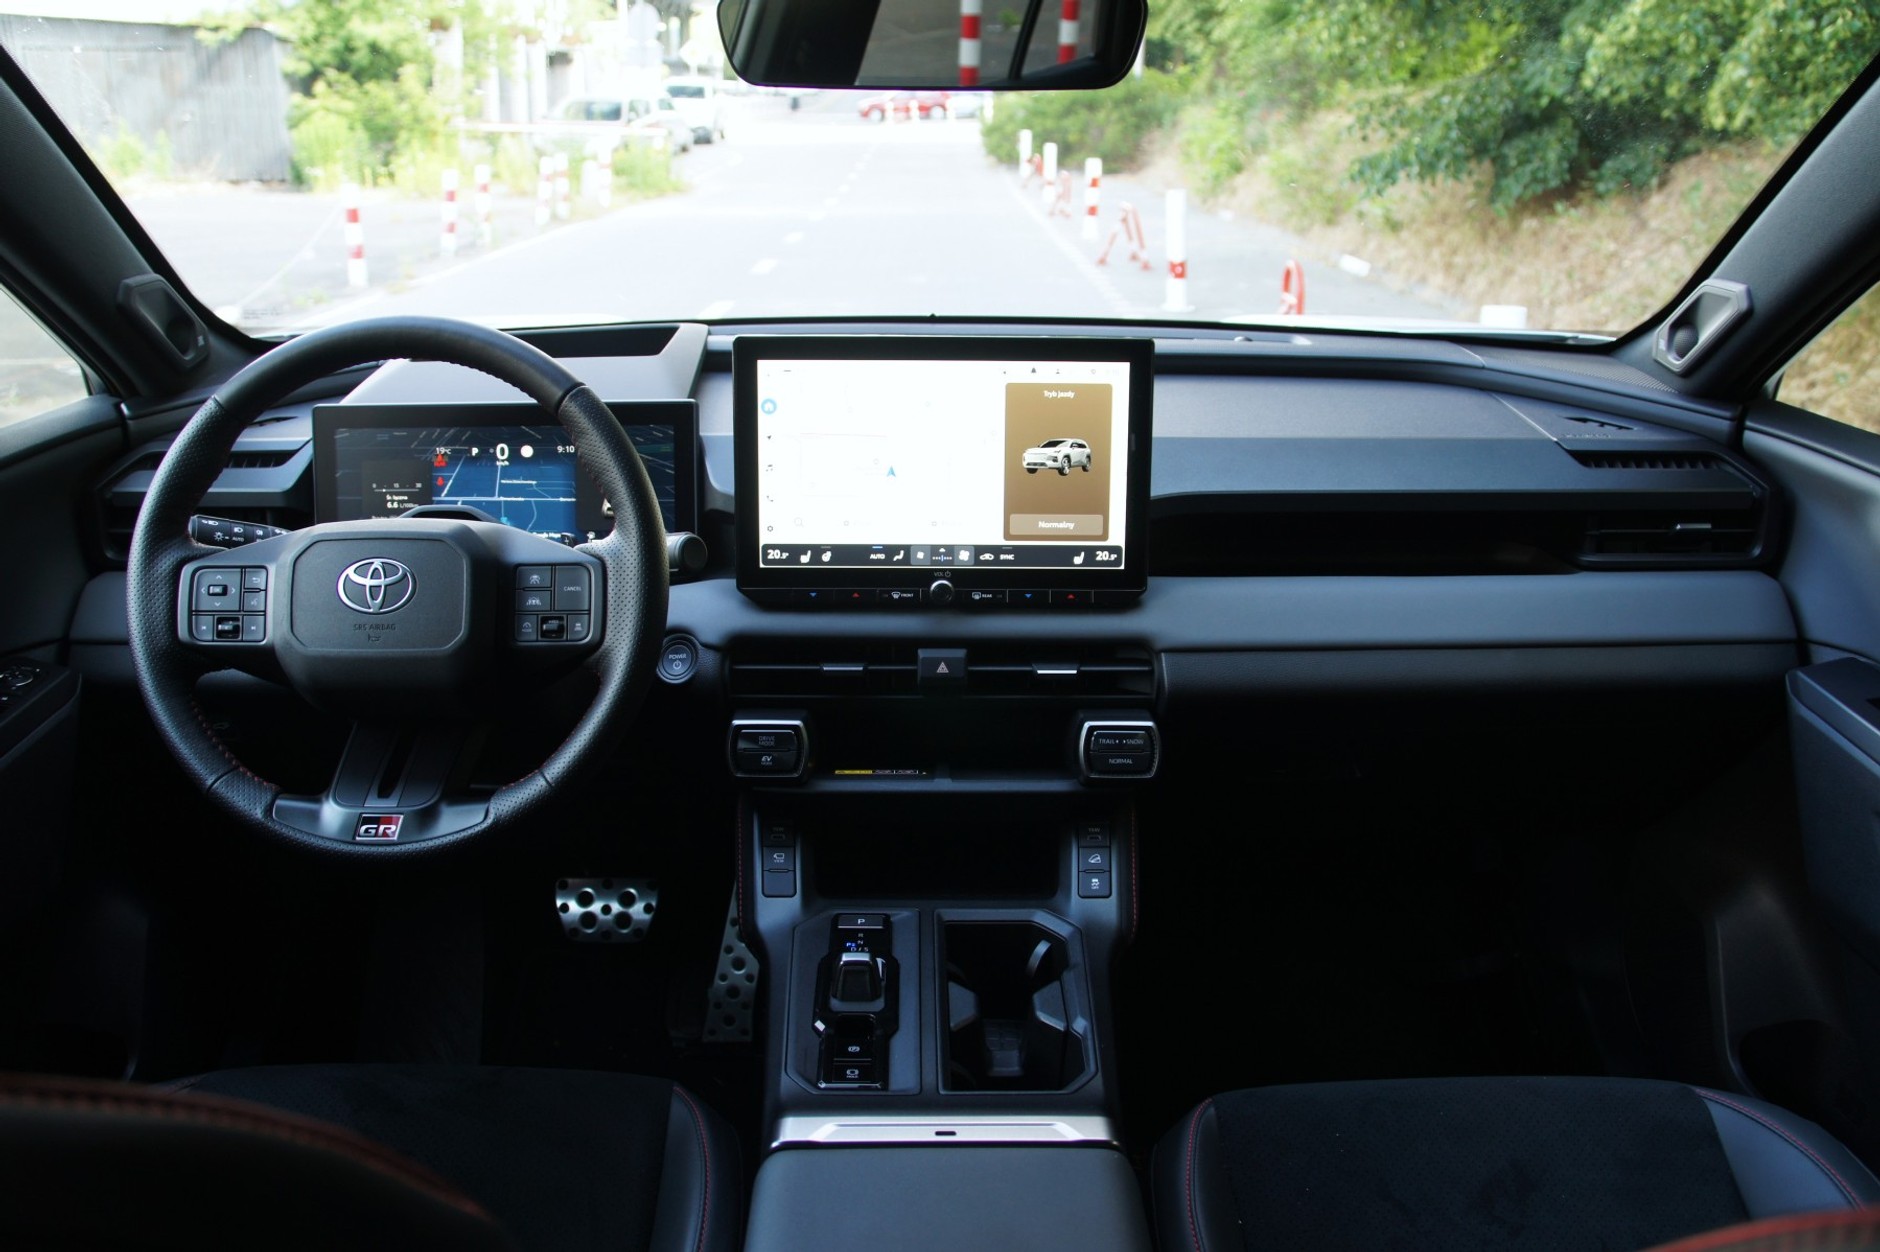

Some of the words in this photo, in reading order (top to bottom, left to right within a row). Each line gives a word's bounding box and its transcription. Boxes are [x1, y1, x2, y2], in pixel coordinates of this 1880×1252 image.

[471, 447, 479, 456] P
[495, 443, 509, 460] 0
[557, 445, 575, 453] 9:10
[386, 501, 399, 509] 6.6
[1038, 521, 1075, 530] Normalny
[353, 623, 367, 631] SRS
[368, 623, 396, 631] AIRBAG
[359, 824, 397, 837] GR
